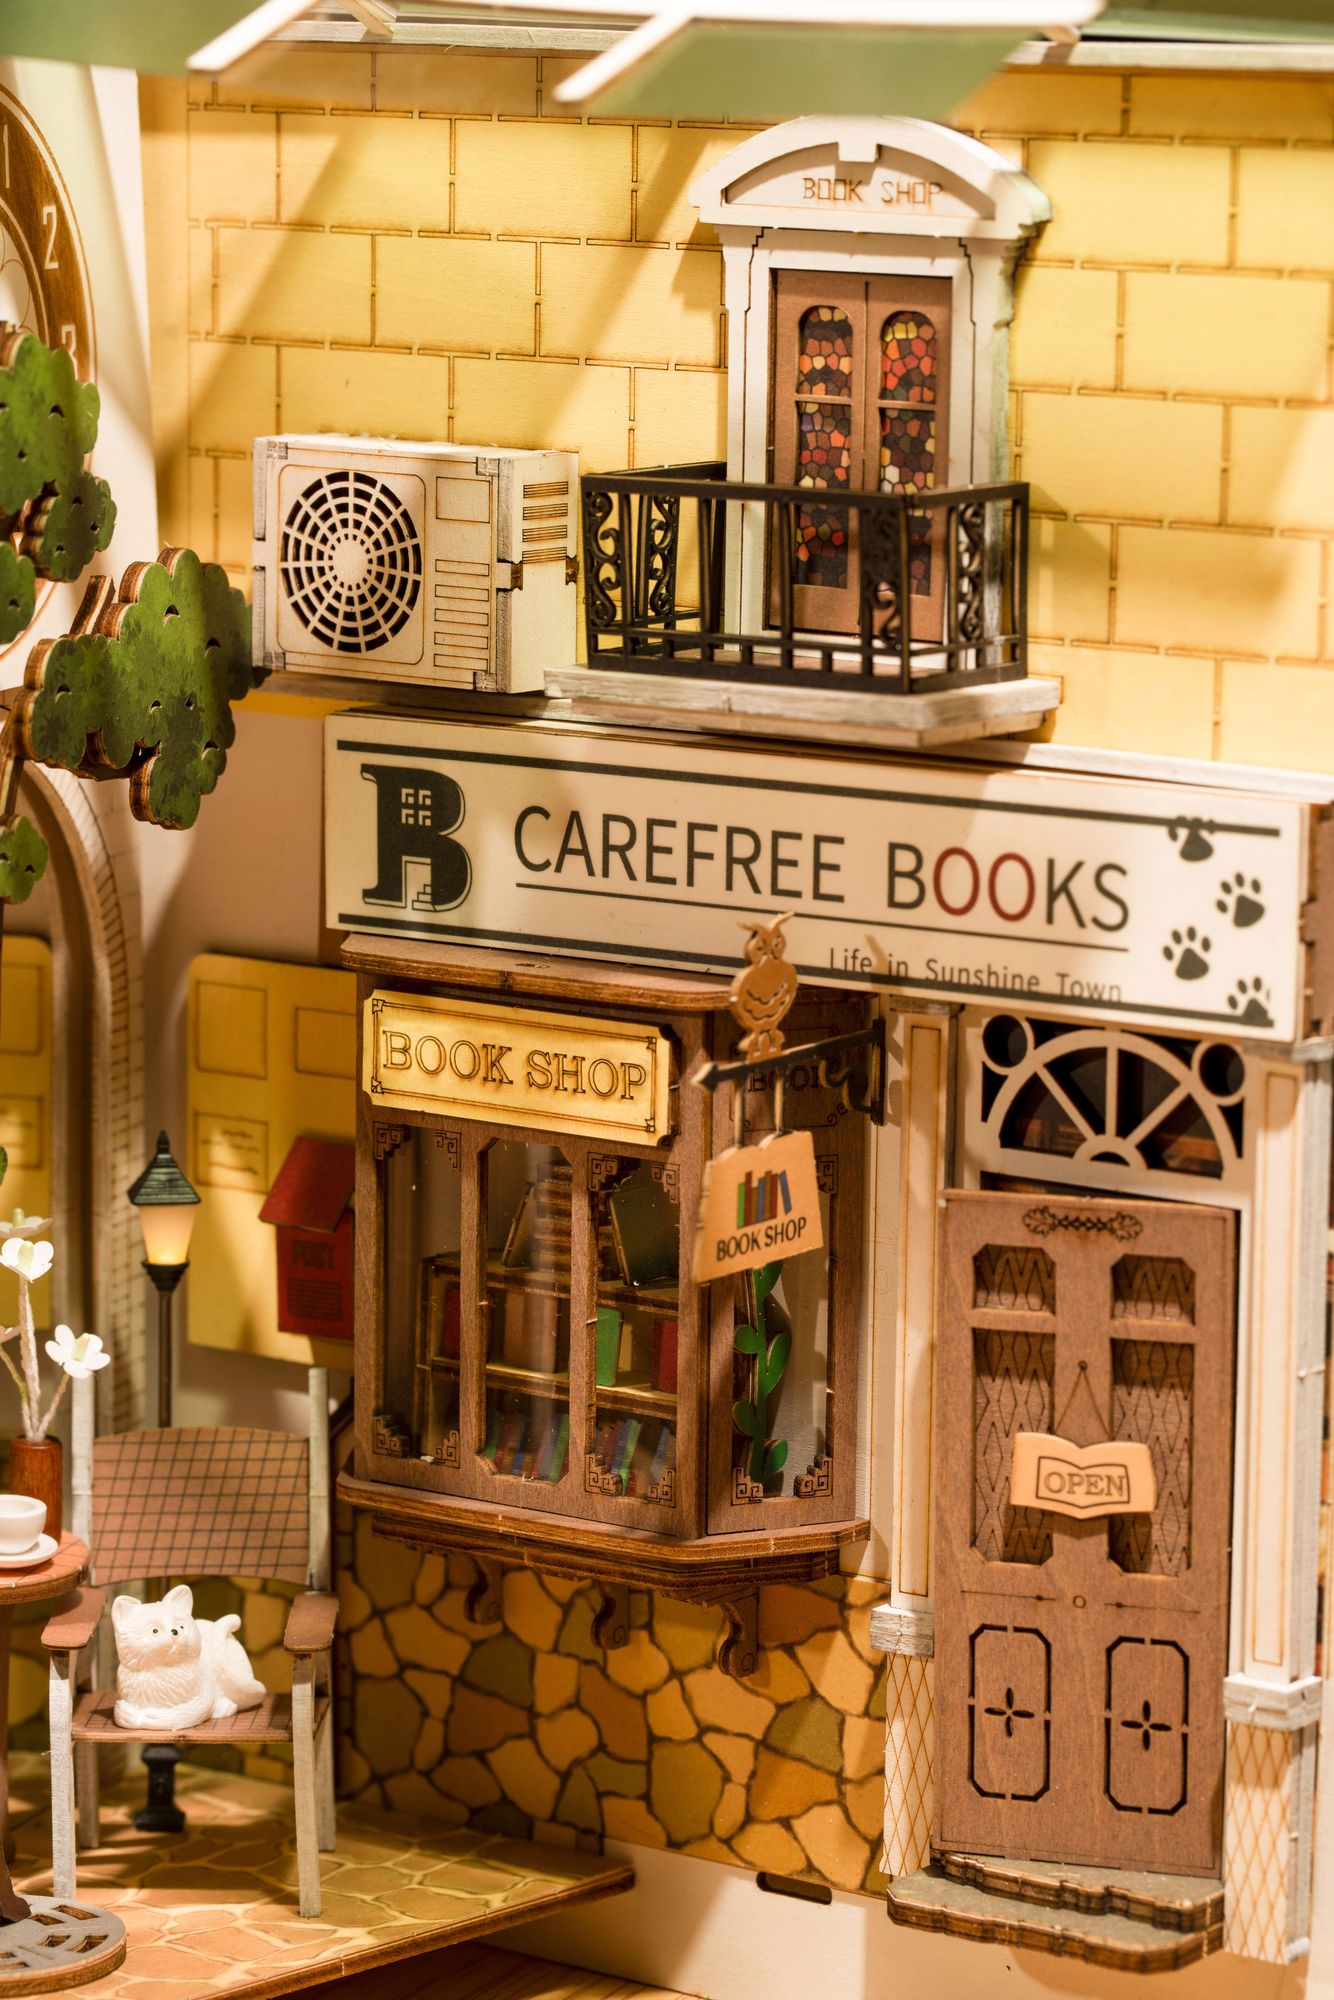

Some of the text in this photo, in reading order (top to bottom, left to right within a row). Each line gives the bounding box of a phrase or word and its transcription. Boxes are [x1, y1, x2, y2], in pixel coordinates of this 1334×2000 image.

[802, 177, 944, 208] BOOK SHOP
[43, 204, 59, 270] 2
[361, 763, 473, 913] B
[514, 805, 1129, 932] CAREFREE BOOKS
[830, 947, 1122, 1002] Life in Sunshine Town
[382, 1030, 647, 1100] BOOK SHOP
[716, 1216, 807, 1261] BOOK SHOP
[1043, 1471, 1126, 1497] OPEN
